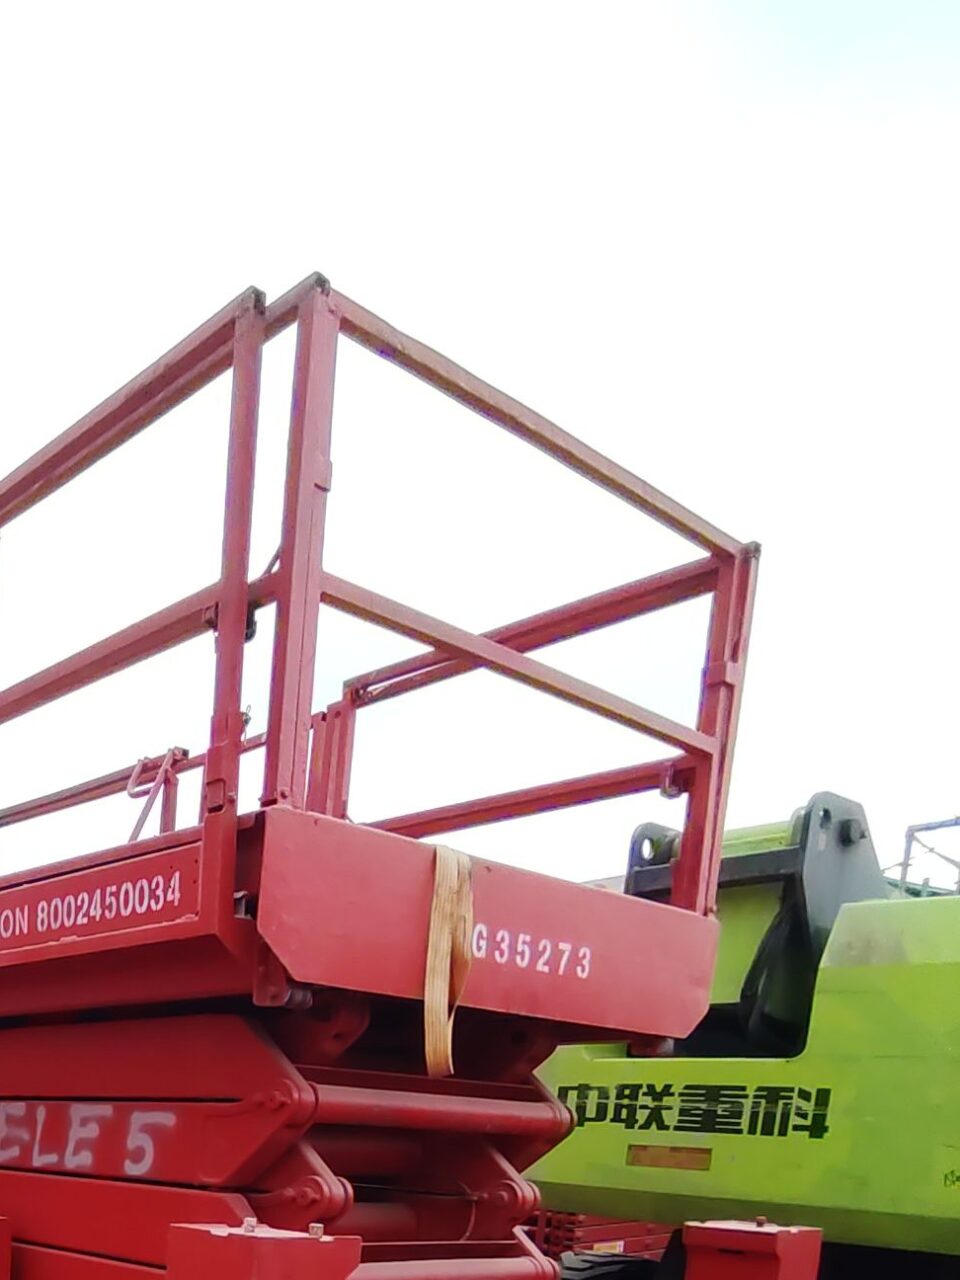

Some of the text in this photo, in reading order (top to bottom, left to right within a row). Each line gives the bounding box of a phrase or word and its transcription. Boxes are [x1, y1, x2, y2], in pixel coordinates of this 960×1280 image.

[36, 870, 181, 933] 8002450034
[557, 1083, 832, 1140] 中联重科
[123, 1111, 177, 1176] 5
